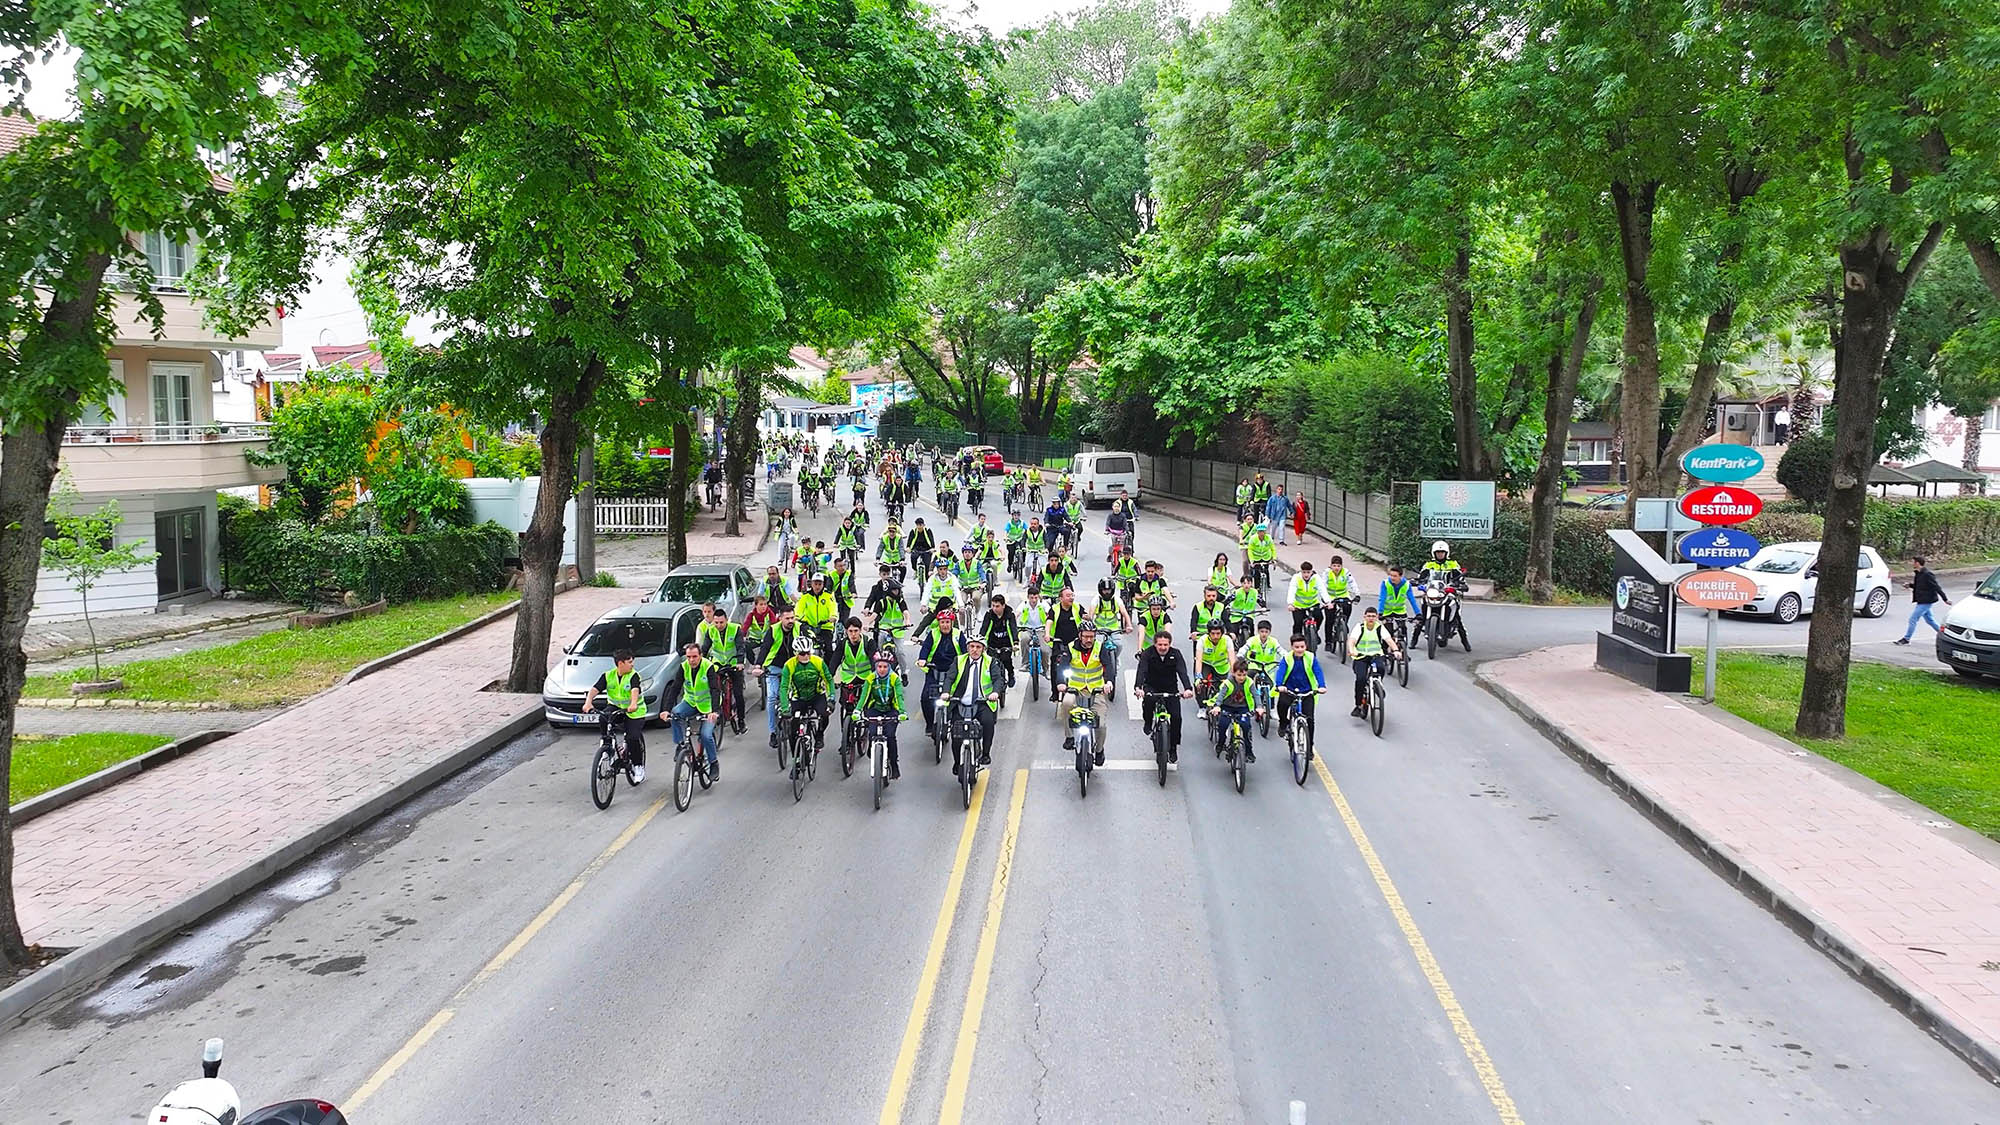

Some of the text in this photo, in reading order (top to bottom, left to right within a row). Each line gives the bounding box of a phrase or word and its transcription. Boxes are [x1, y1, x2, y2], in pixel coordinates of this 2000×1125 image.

[1691, 457, 1746, 468] KentPark
[1691, 504, 1753, 515] RESTORAN
[1424, 516, 1489, 528] ÖĞRETMENEVİ
[1690, 547, 1750, 558] KAFETERYA
[1686, 580, 1737, 591] AÇIKBÜFE
[1700, 591, 1748, 600] KAHVALTI
